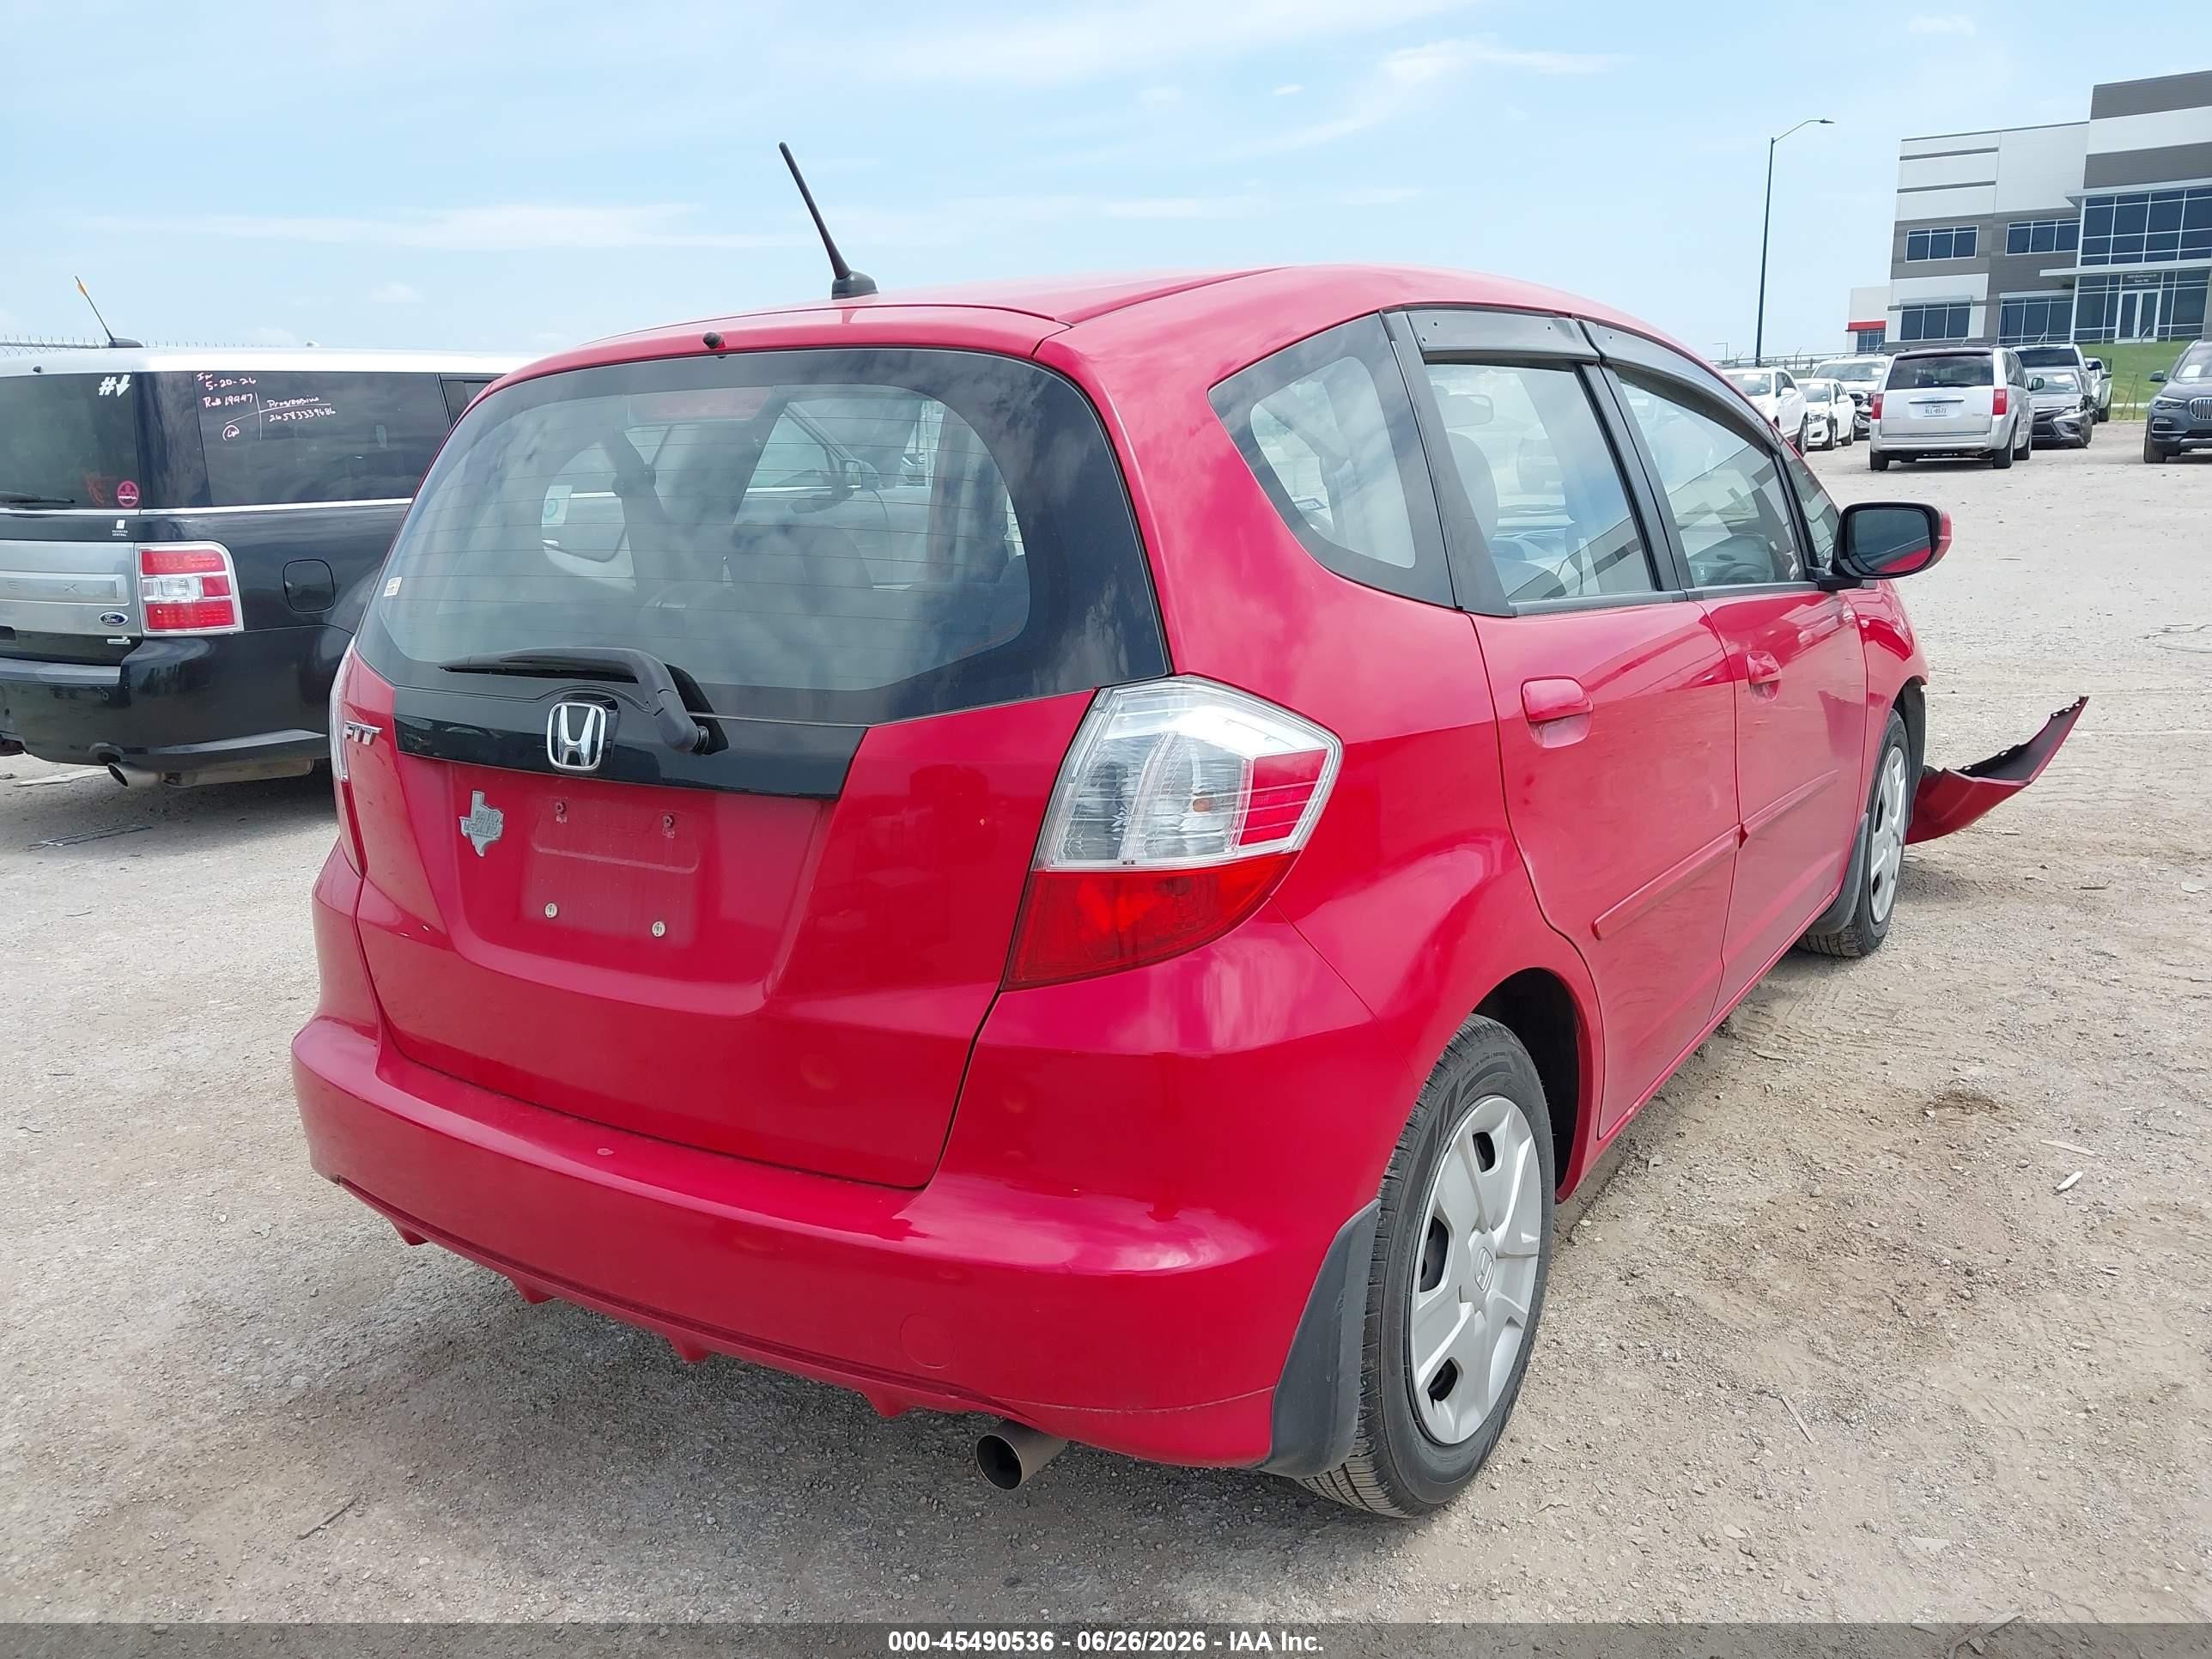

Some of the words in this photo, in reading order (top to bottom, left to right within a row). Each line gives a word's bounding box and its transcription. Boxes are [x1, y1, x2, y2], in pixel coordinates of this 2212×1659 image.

[205, 377, 257, 391] 5-20-26
[101, 613, 125, 625] Ford
[343, 720, 383, 746] FIT
